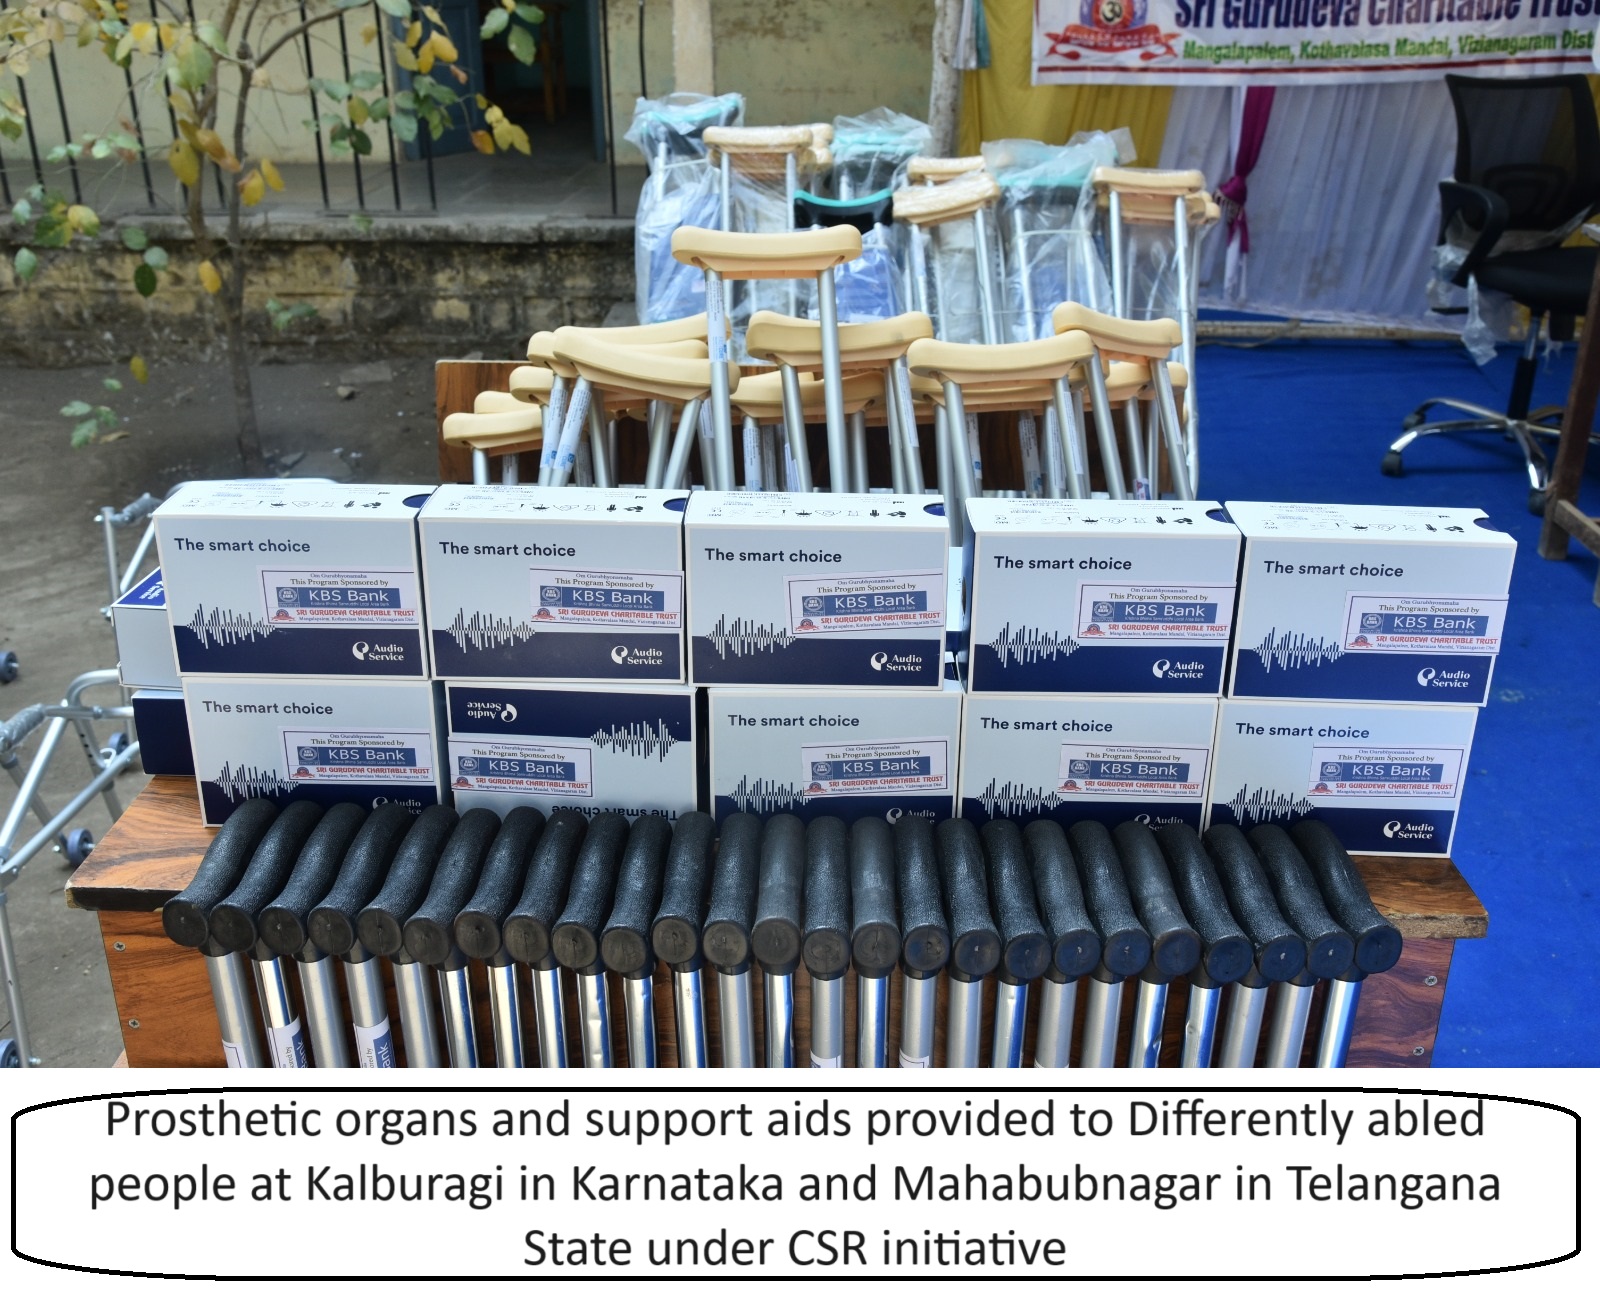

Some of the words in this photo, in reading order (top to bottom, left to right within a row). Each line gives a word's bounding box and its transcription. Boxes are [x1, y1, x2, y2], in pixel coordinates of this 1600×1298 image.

[174, 538, 204, 550] The
[209, 540, 254, 552] smart
[259, 540, 310, 552] choice
[439, 542, 469, 554] The
[474, 543, 518, 555] smart
[524, 544, 576, 556] choice
[705, 548, 734, 560] The
[740, 550, 784, 562] smart
[789, 550, 841, 562] choice
[994, 556, 1023, 568] The
[1029, 557, 1074, 569] smart
[1079, 557, 1132, 570] choice
[1264, 561, 1294, 574] The
[1299, 563, 1344, 575] smart
[1350, 564, 1403, 577] choice
[835, 585, 865, 593] Program
[868, 584, 905, 592] Sponsored
[309, 590, 342, 601] KBS
[348, 590, 388, 601] Bank
[573, 590, 604, 602] KBS
[612, 592, 652, 604] Bank
[1199, 594, 1208, 602] by
[835, 597, 867, 609] KBS
[874, 594, 915, 606] Bank
[1125, 605, 1158, 616] KBS
[1164, 605, 1205, 616] Bank
[1394, 617, 1427, 628] KBS
[1433, 618, 1475, 629] Bank
[374, 644, 403, 652] Audio
[632, 649, 662, 657] Audio
[369, 652, 404, 661] Service
[627, 656, 662, 665] Service
[892, 655, 922, 663] Audio
[887, 663, 921, 671] Service
[1174, 662, 1204, 670] Audio
[1168, 670, 1203, 678] Service
[1439, 671, 1470, 679] Audio
[1432, 679, 1468, 688] Service
[203, 701, 231, 712] The
[236, 703, 279, 713] smart
[284, 703, 333, 714] choice
[467, 702, 501, 711] Service
[468, 710, 496, 719] Audio
[728, 715, 756, 726] The
[761, 716, 804, 726] smart
[809, 715, 859, 726] choice
[981, 718, 1009, 729] The
[1014, 719, 1057, 730] smart
[1062, 720, 1113, 732] choice
[1236, 723, 1264, 735] The
[1269, 725, 1313, 736] smart
[1318, 726, 1369, 739] choice
[329, 750, 359, 759] KBS
[366, 750, 405, 760] Bank
[489, 760, 520, 771] KBS
[526, 762, 564, 774] Bank
[843, 762, 873, 773] KBS
[881, 760, 919, 771] Bank
[1101, 763, 1132, 774] KBS
[1139, 765, 1178, 775] Bank
[1352, 765, 1384, 775] KBS
[1391, 765, 1431, 776] Bank
[1404, 823, 1434, 832] Audio
[1398, 831, 1432, 839] Service
